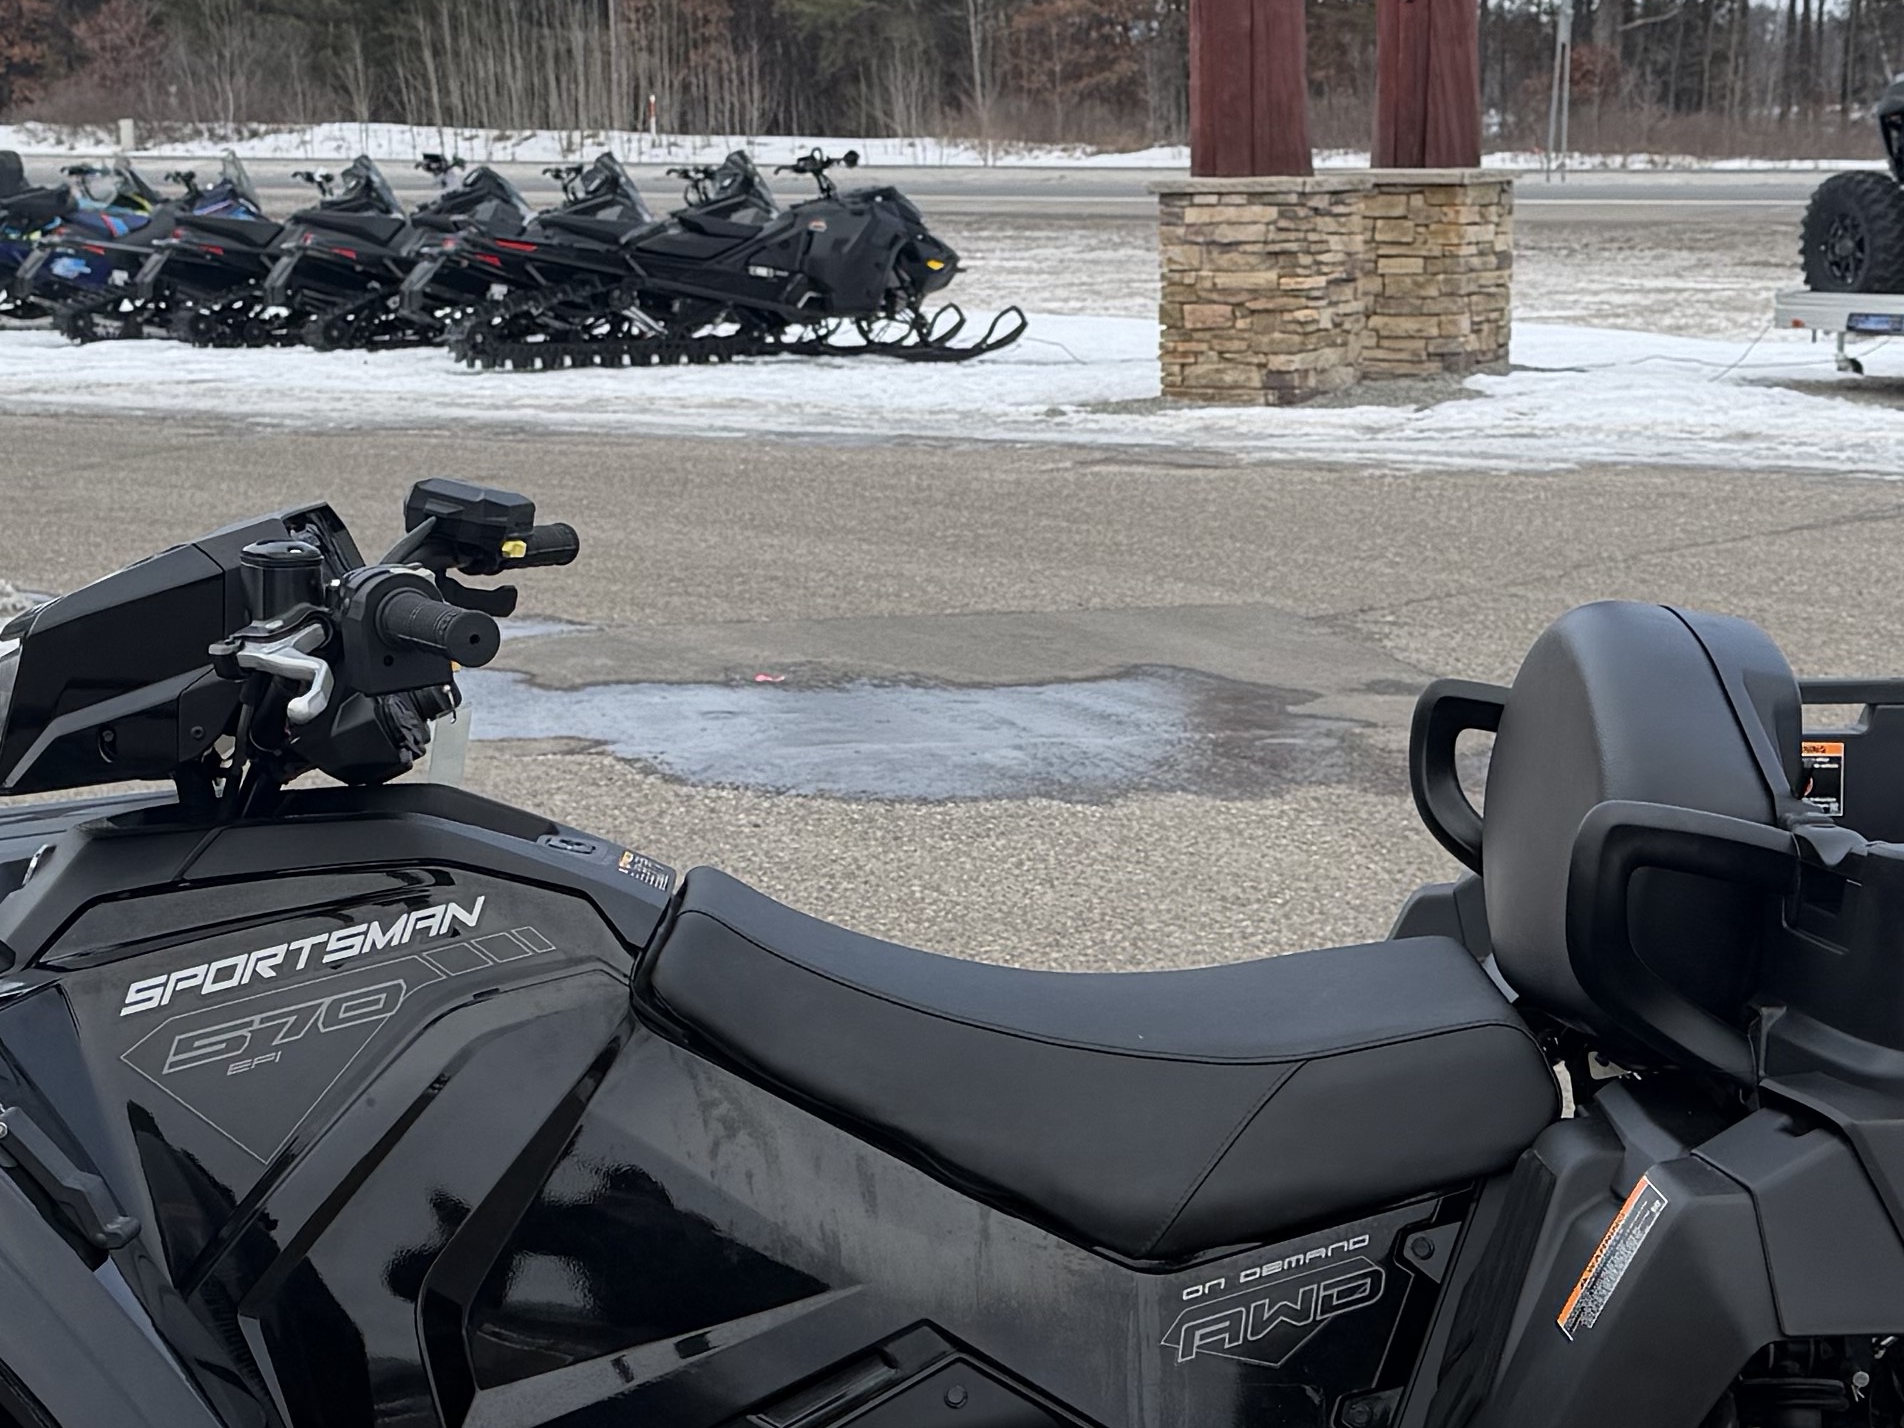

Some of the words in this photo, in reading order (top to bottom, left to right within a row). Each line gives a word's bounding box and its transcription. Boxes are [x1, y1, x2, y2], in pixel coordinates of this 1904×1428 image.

[120, 895, 485, 1016] SPORTSMAN
[162, 979, 407, 1075] 570
[1175, 1267, 1386, 1363] AWD
